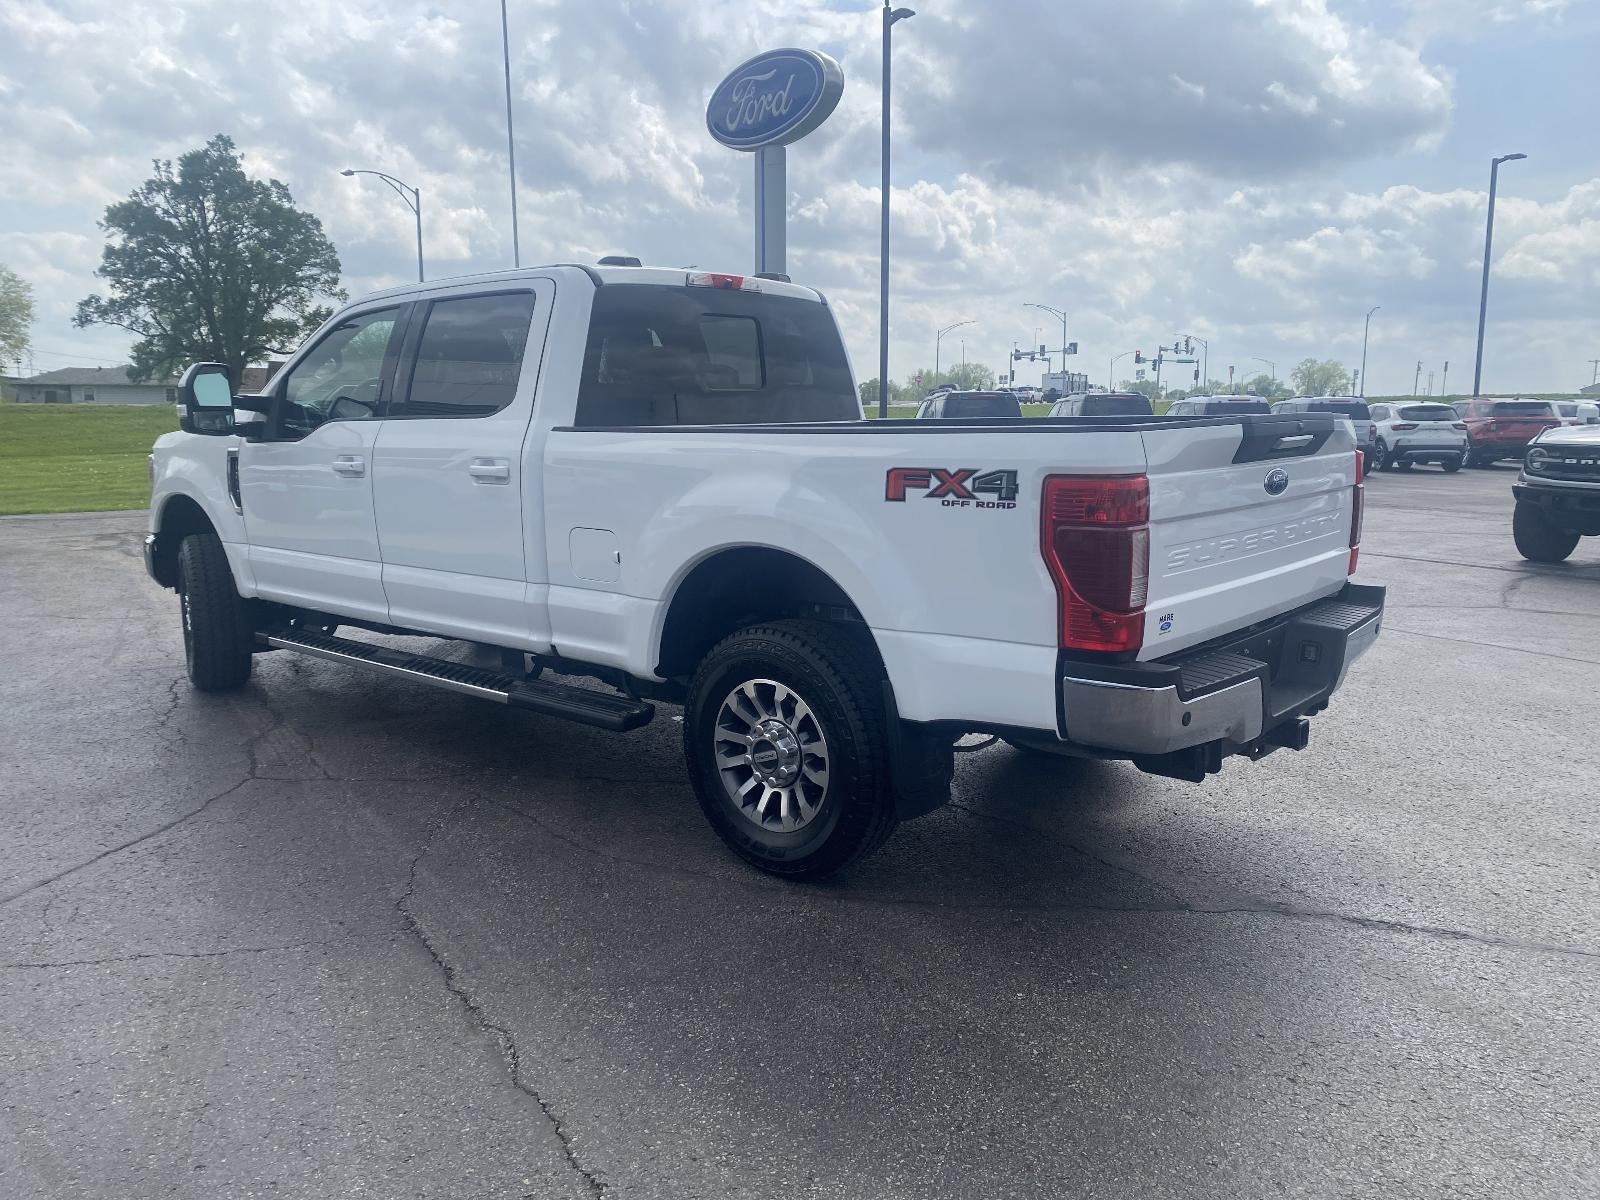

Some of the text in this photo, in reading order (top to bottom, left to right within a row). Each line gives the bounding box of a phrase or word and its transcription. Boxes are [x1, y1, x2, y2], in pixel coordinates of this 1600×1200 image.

[726, 68, 795, 132] Ford
[885, 467, 1019, 502] FX4
[941, 499, 1017, 509] OFF ROAD
[1166, 512, 1341, 570] SUPER DUTY
